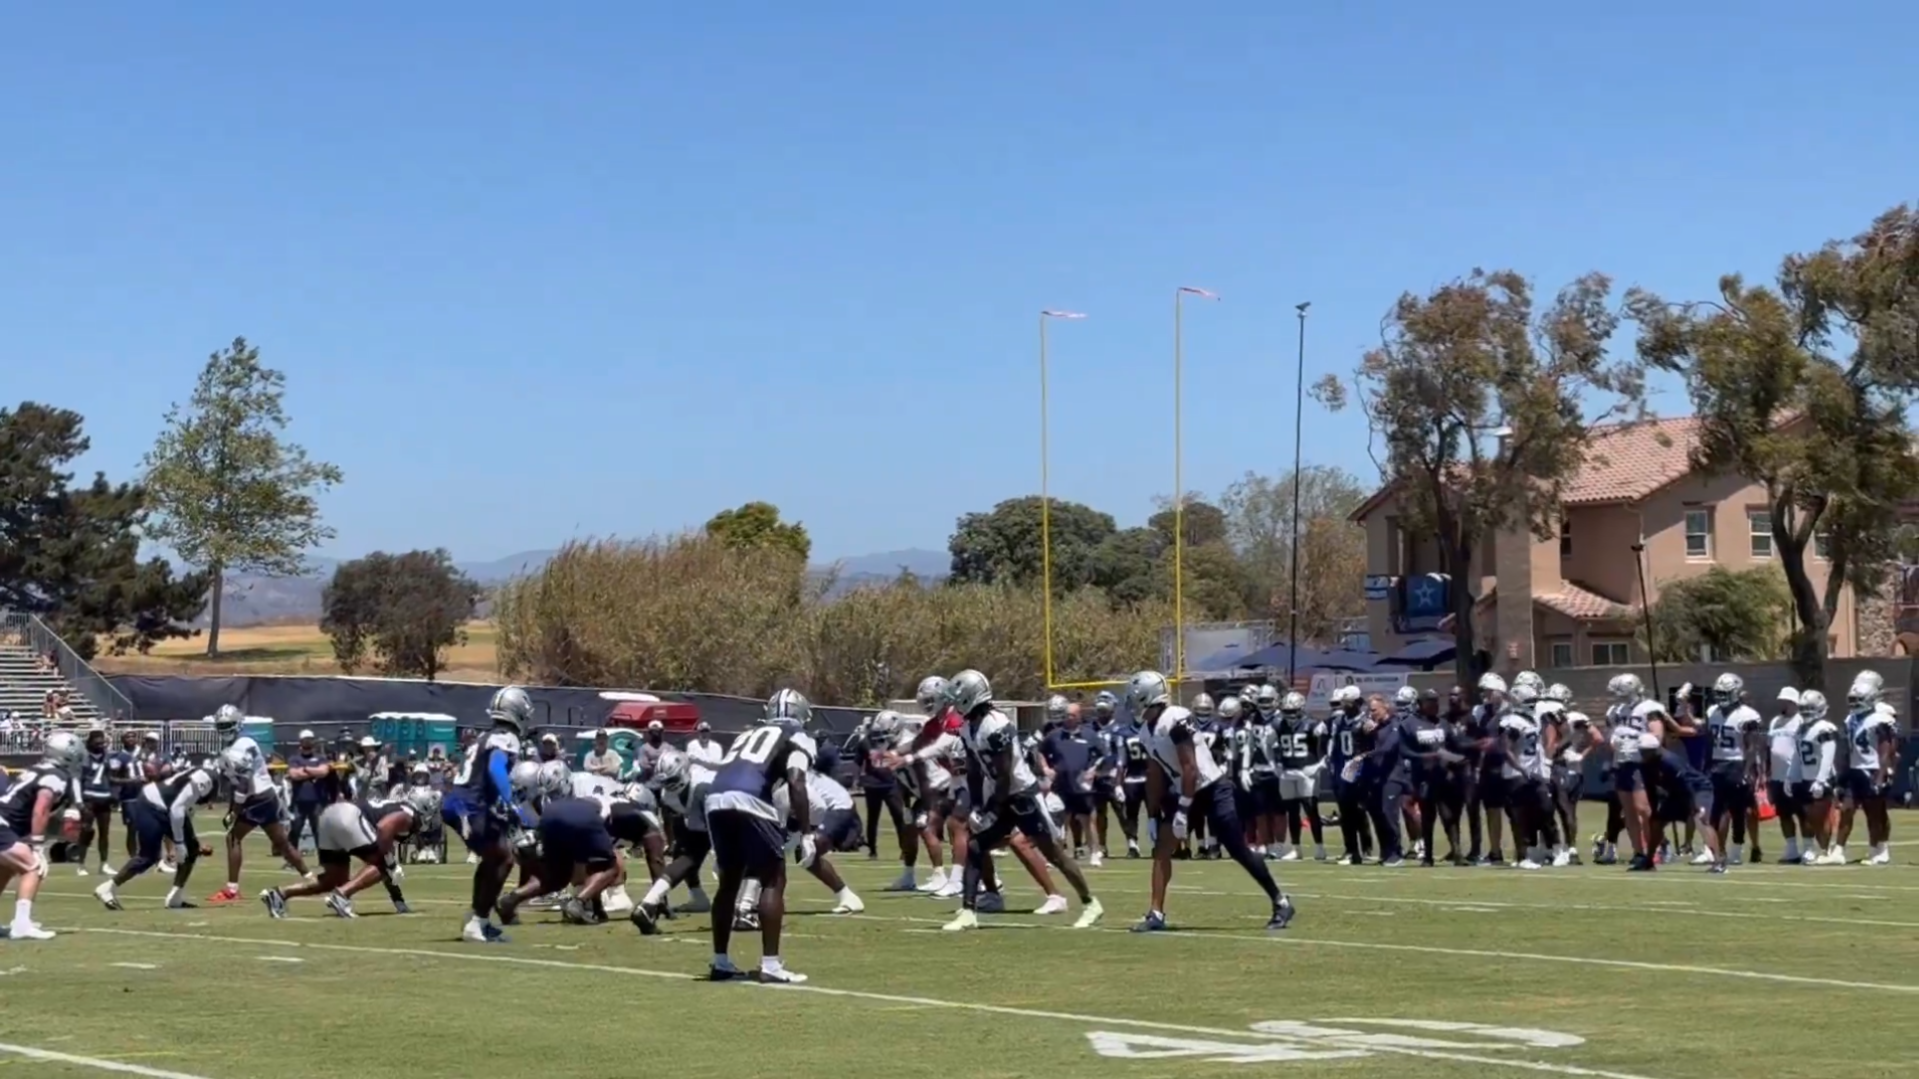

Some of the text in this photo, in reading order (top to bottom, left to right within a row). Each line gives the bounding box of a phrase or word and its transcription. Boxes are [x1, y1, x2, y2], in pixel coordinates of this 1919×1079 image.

[1280, 733, 1308, 757] 95
[1340, 730, 1354, 756] 0
[92, 763, 104, 784] 7
